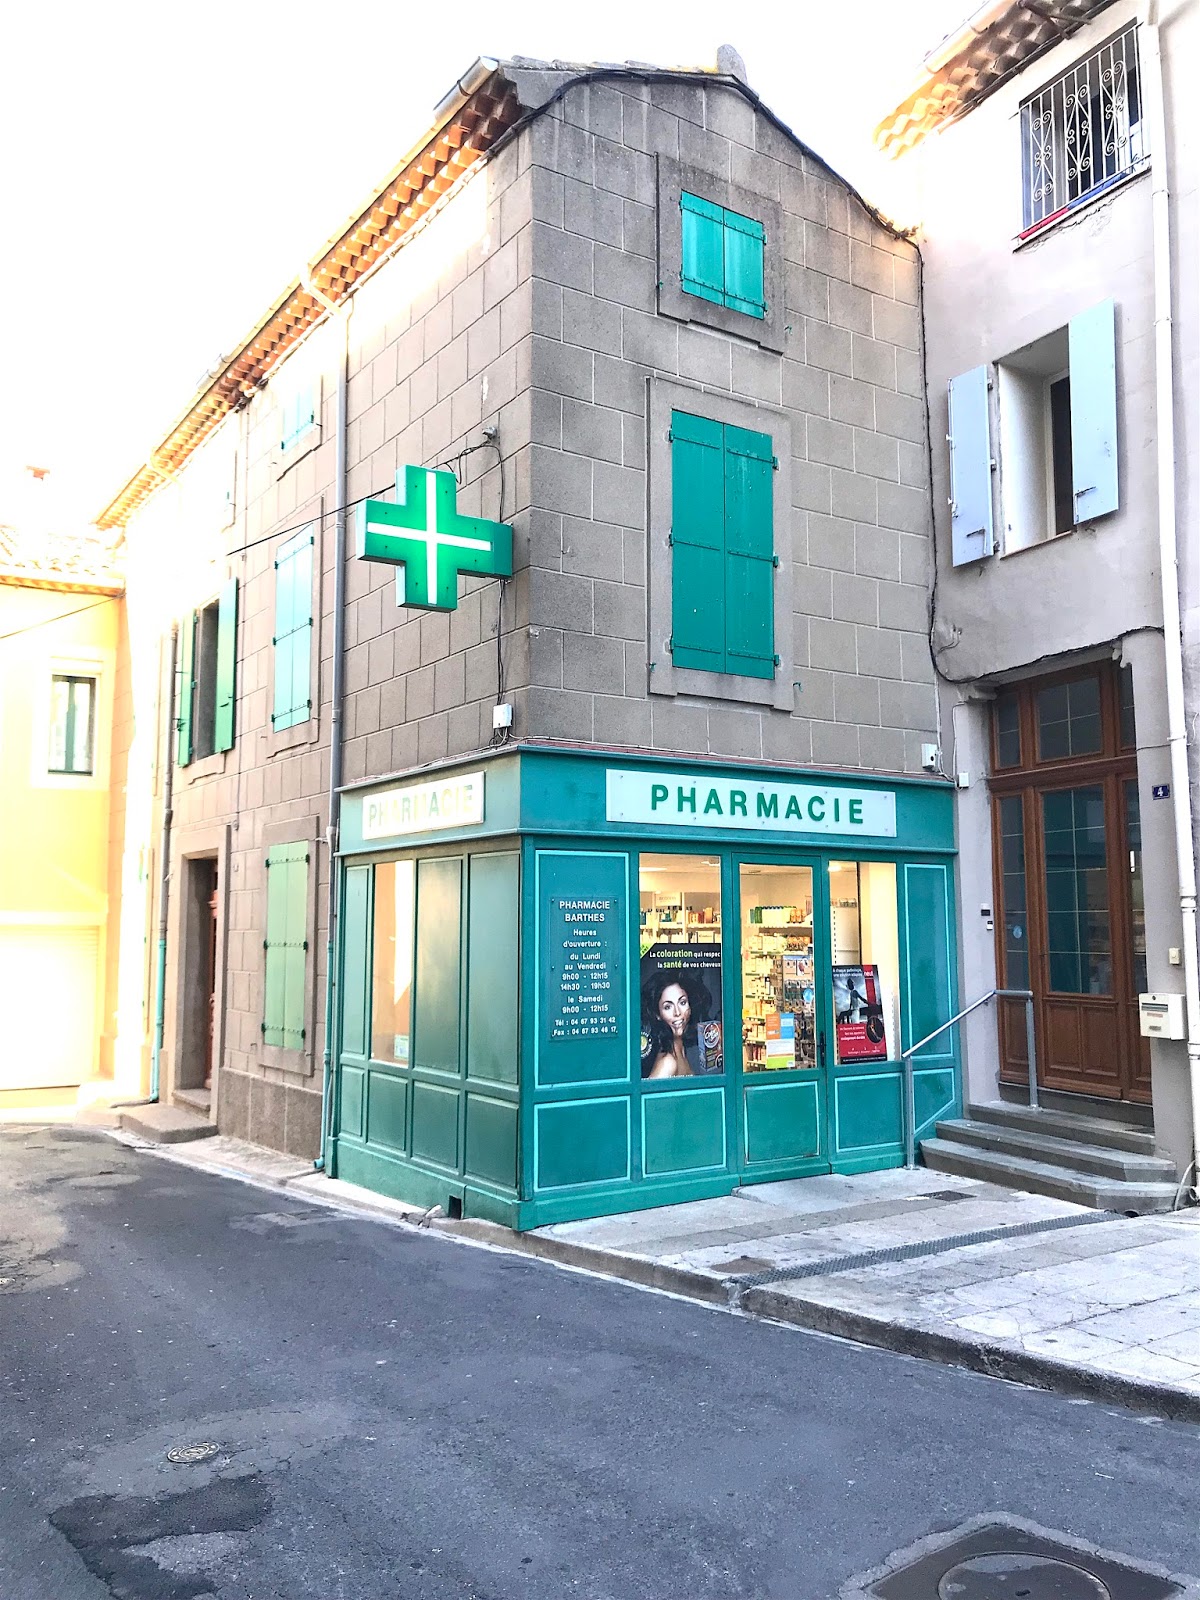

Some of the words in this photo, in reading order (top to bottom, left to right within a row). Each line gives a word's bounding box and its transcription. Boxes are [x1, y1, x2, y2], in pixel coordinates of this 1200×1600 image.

[1157, 786, 1164, 797] 4
[651, 784, 864, 824] PHARMACIE
[559, 900, 610, 909] PHARMACIE
[564, 913, 605, 922] BARTHES
[563, 940, 601, 948] d'ouverture
[582, 952, 601, 960] Lundi
[656, 949, 693, 958] coloration
[693, 951, 703, 959] qui
[577, 962, 606, 970] Vendredi
[663, 960, 682, 969] santé
[562, 973, 580, 981] 9h00
[590, 972, 608, 980] 12h15
[560, 983, 580, 991] 14h30
[591, 981, 611, 990] 19h30
[567, 995, 575, 1003] le
[578, 994, 603, 1003] Samedi
[562, 1006, 580, 1014] 9h00
[590, 1004, 609, 1012] 12h15
[589, 1017, 598, 1025] 93
